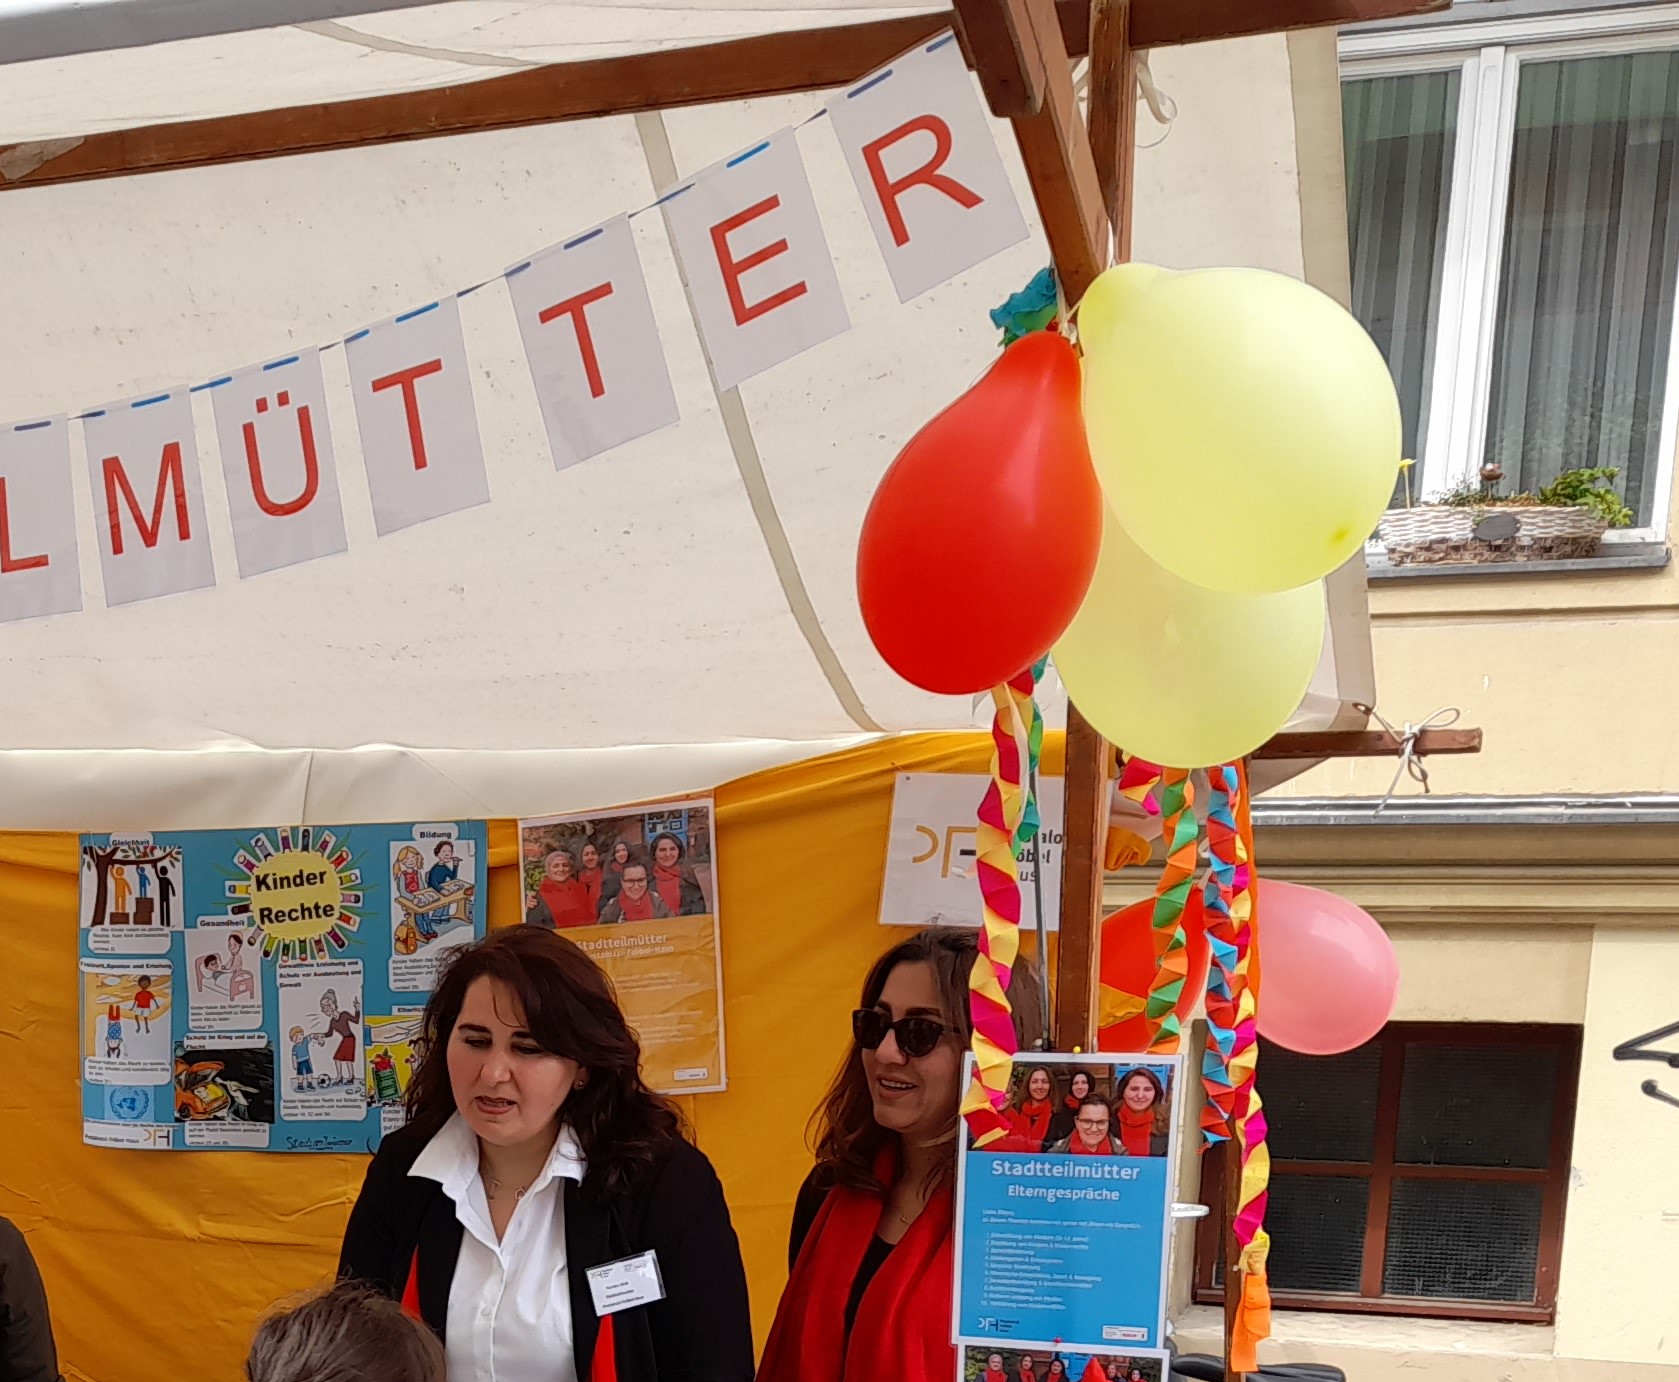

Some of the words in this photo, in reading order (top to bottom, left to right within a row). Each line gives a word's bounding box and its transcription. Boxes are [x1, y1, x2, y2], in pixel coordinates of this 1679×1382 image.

[254, 868, 328, 893] Kinder
[259, 900, 335, 926] Rechte
[991, 1159, 1141, 1180] Stadtteilmütter
[1007, 1184, 1120, 1203] Elterngespräche
